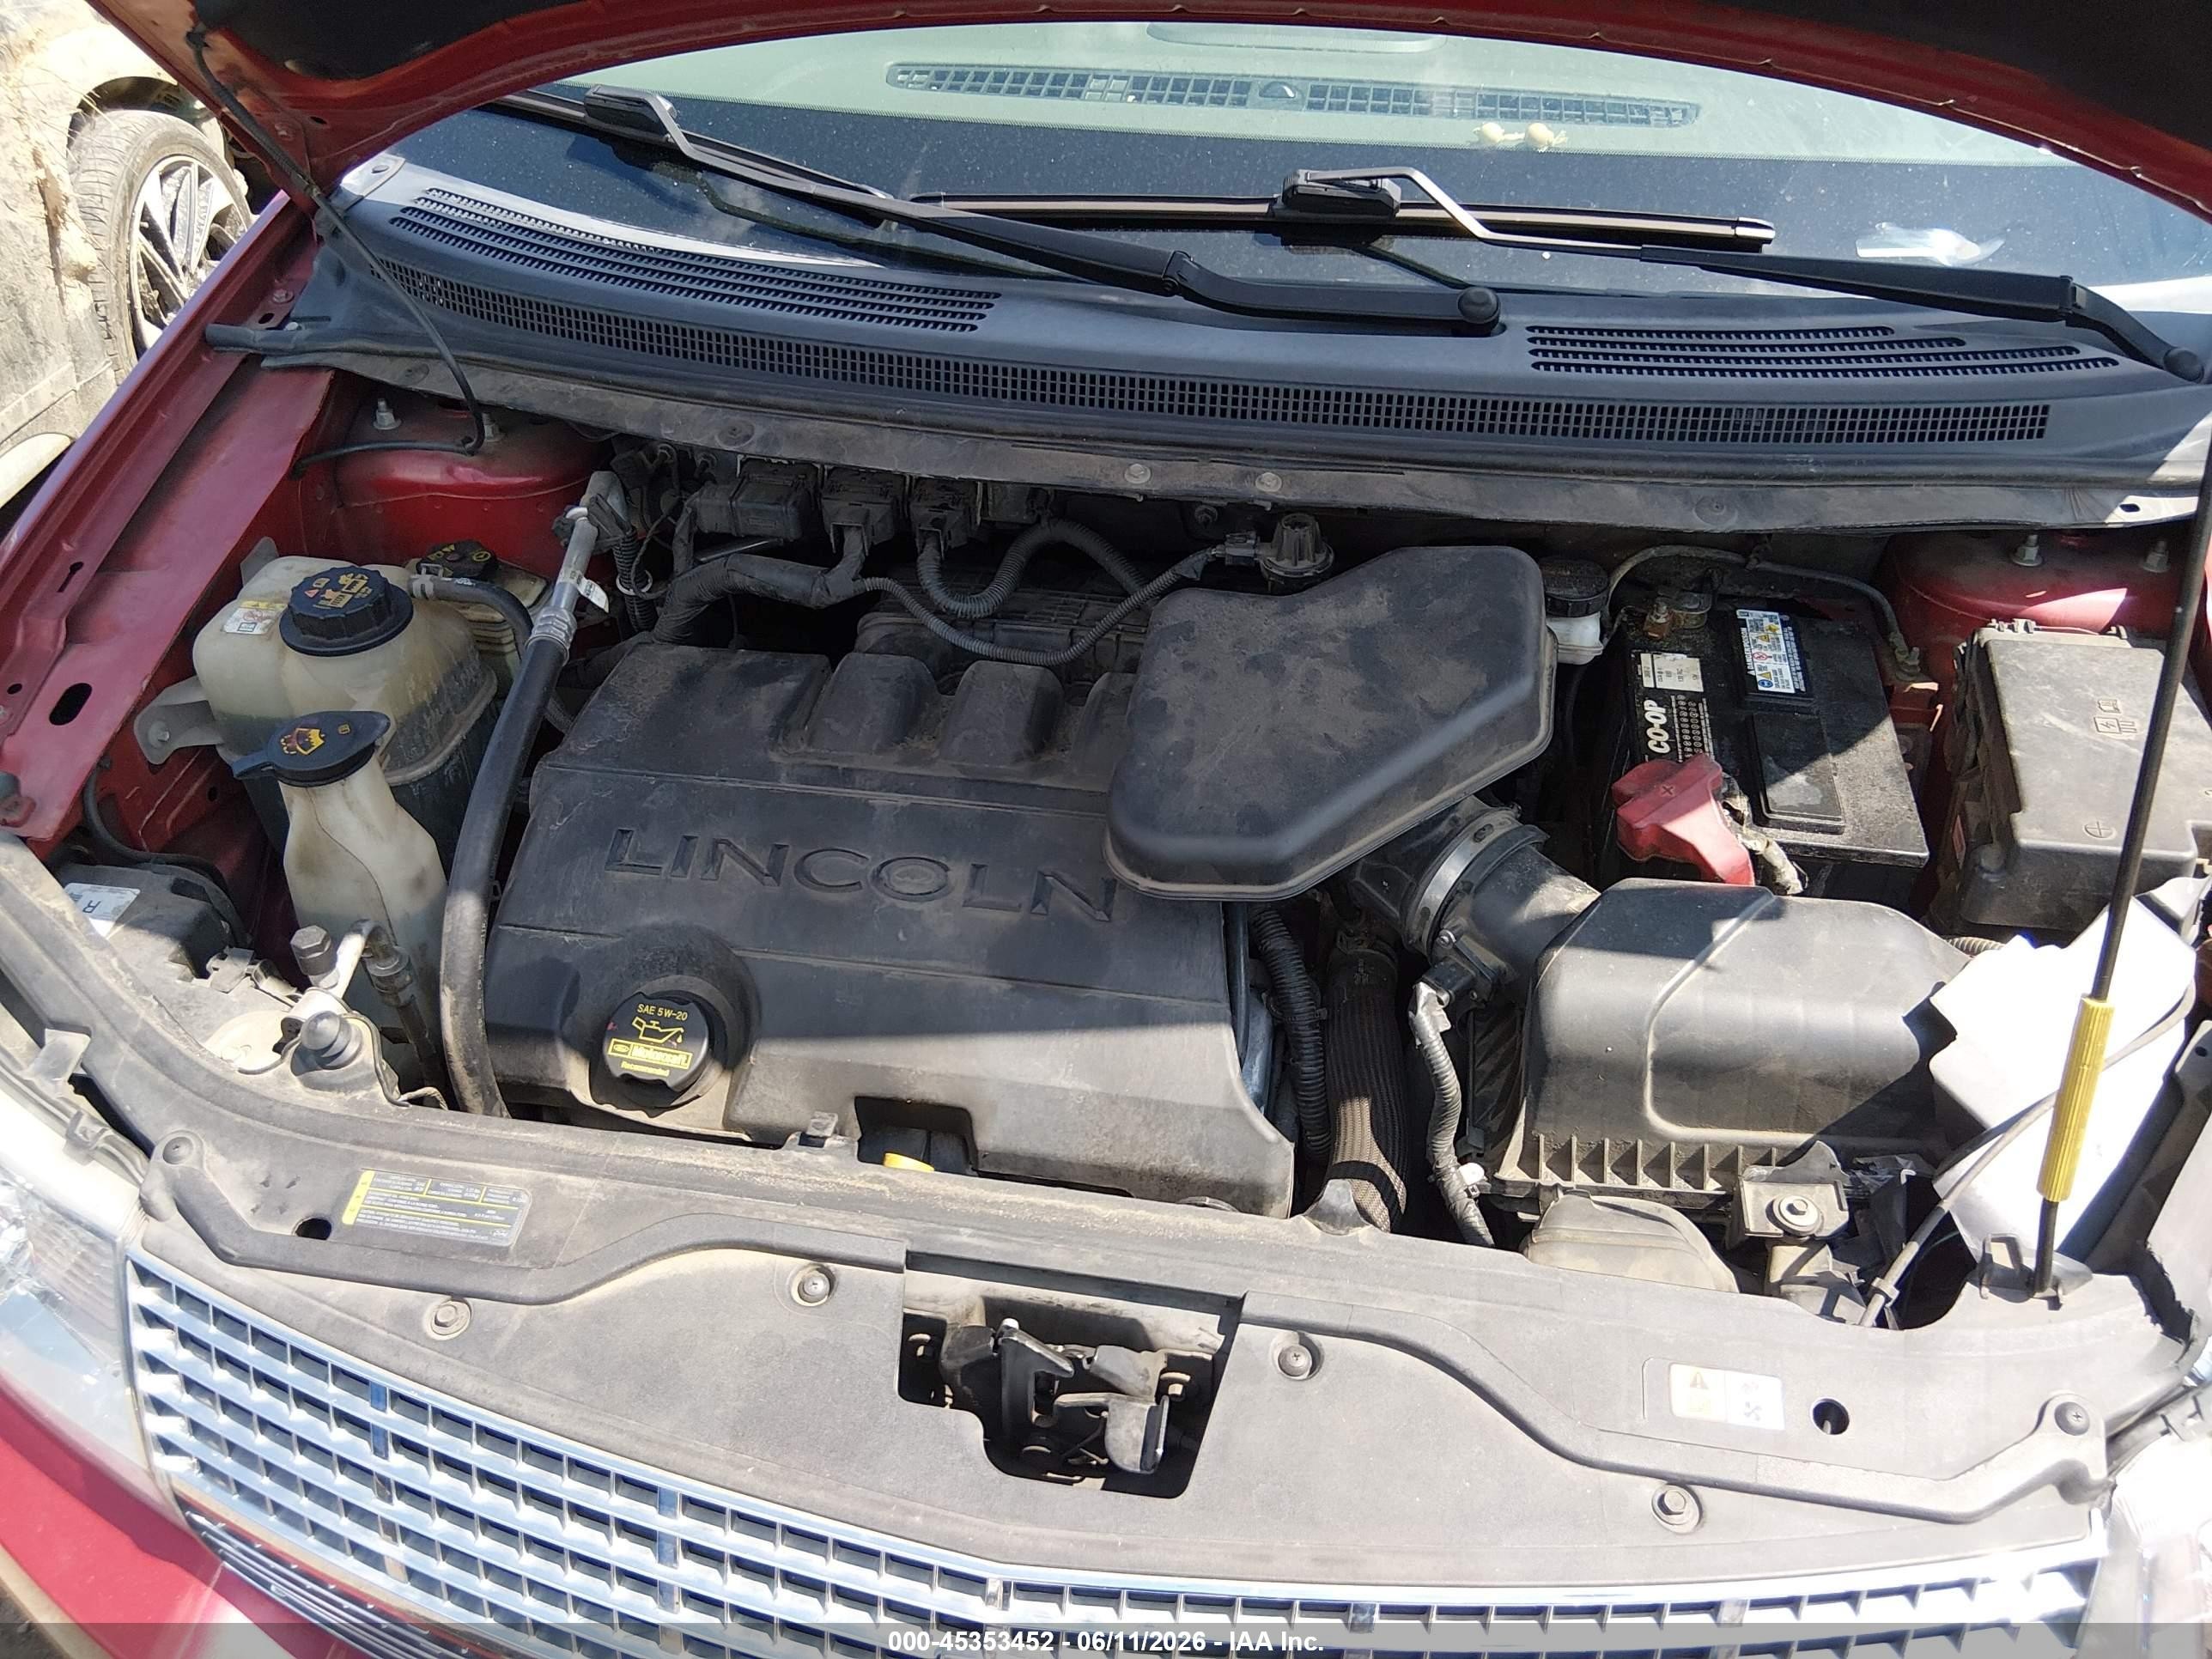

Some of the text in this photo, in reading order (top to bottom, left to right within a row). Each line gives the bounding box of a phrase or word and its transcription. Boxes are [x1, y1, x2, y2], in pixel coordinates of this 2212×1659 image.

[1644, 699, 1671, 754] CO-OP
[605, 827, 1117, 922] LINCOLN
[637, 1003, 688, 1021] SAE 5W-20
